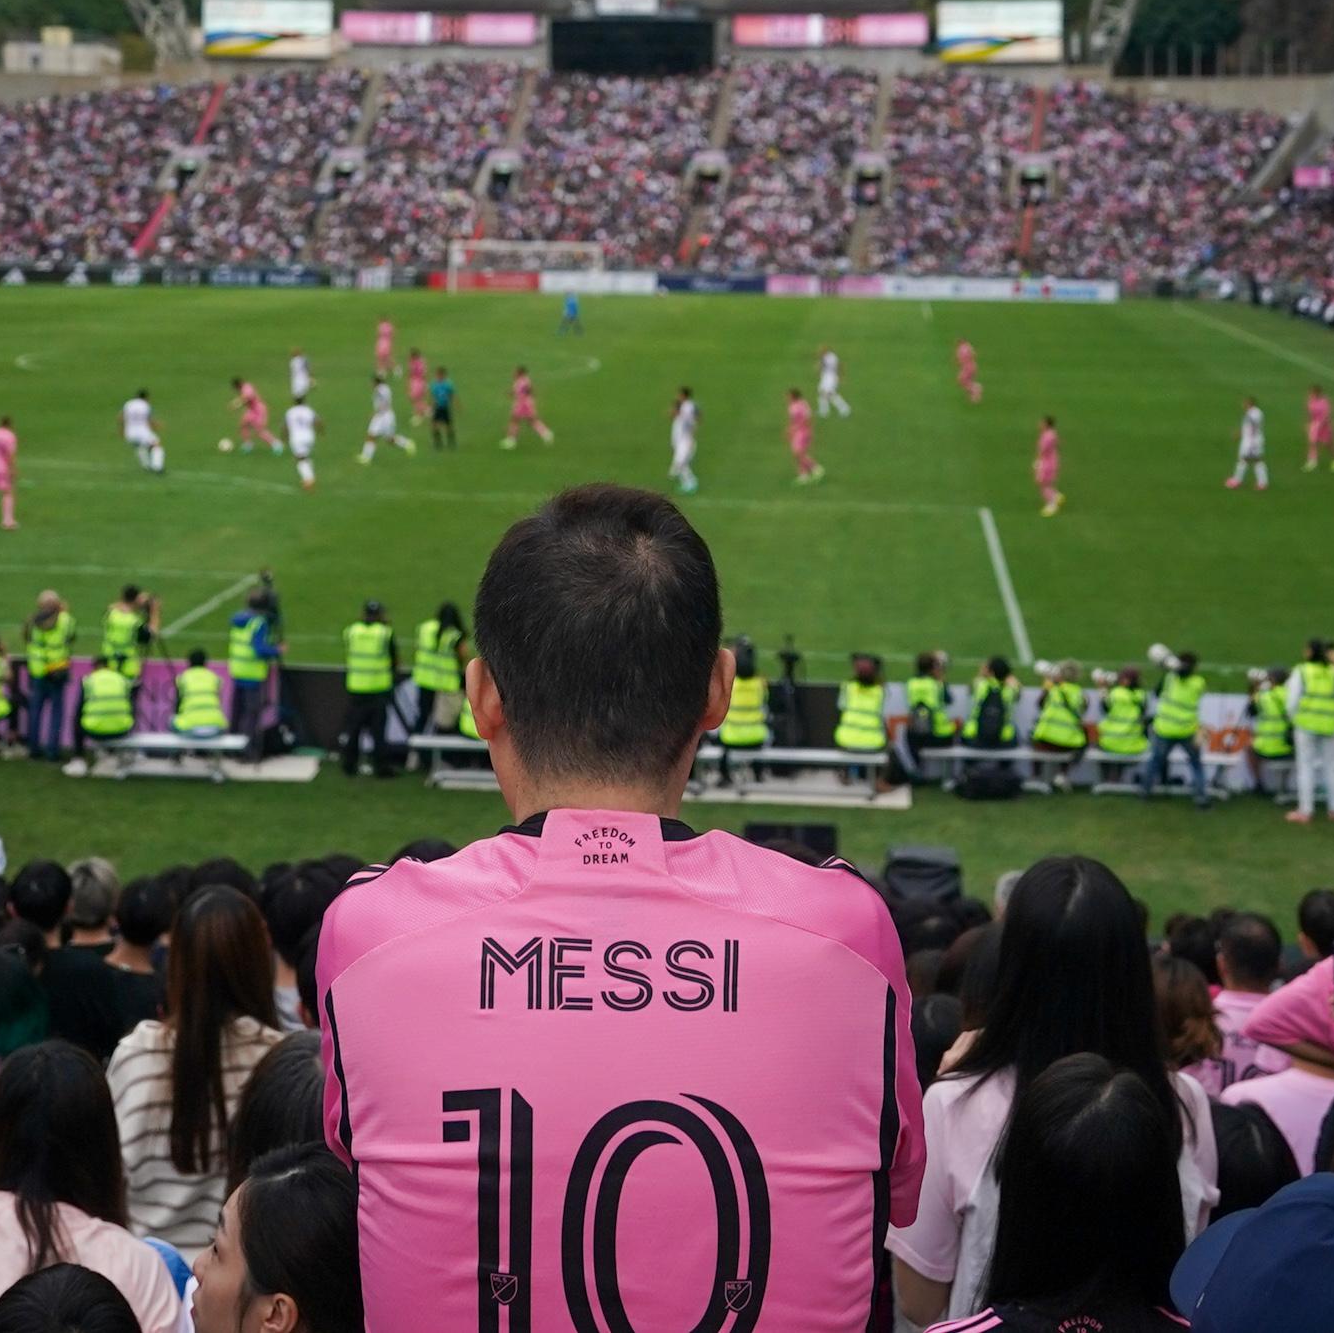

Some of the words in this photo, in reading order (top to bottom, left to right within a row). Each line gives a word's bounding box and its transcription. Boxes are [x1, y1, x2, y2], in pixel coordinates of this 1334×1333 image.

[574, 827, 636, 847] FREEDOM
[583, 853, 629, 864] DREAM
[479, 936, 739, 1013] MESSI
[442, 1087, 771, 1333] 10
